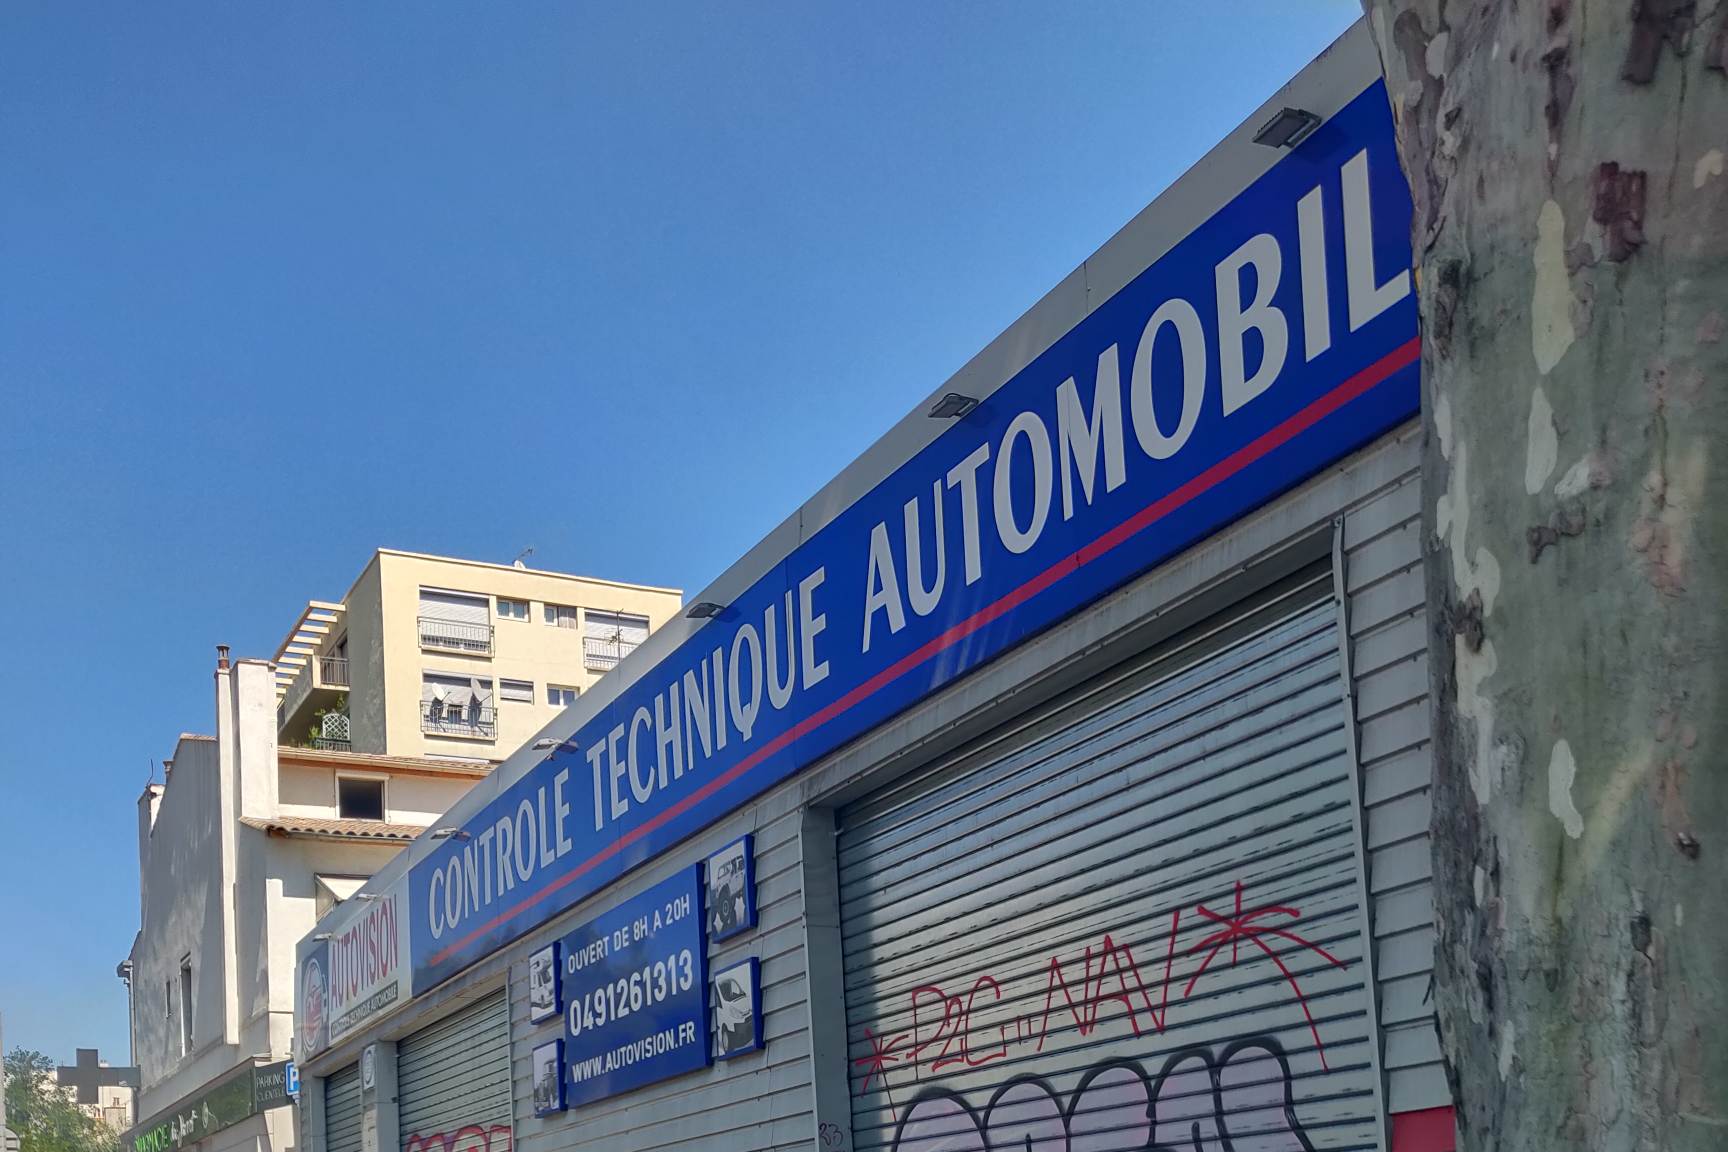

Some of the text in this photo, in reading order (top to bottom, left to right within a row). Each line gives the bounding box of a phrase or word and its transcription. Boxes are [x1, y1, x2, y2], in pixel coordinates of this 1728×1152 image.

[428, 766, 573, 941] CONTROLE
[586, 565, 831, 832] TECHNIQUE
[330, 892, 399, 1012] AUTOVISION
[567, 893, 690, 975] OUVERT DE 8H A 20H
[569, 948, 694, 1037] 0491261313
[256, 1070, 286, 1089] PARKING
[571, 1020, 696, 1084] WWW.AUTOVISION.FR
